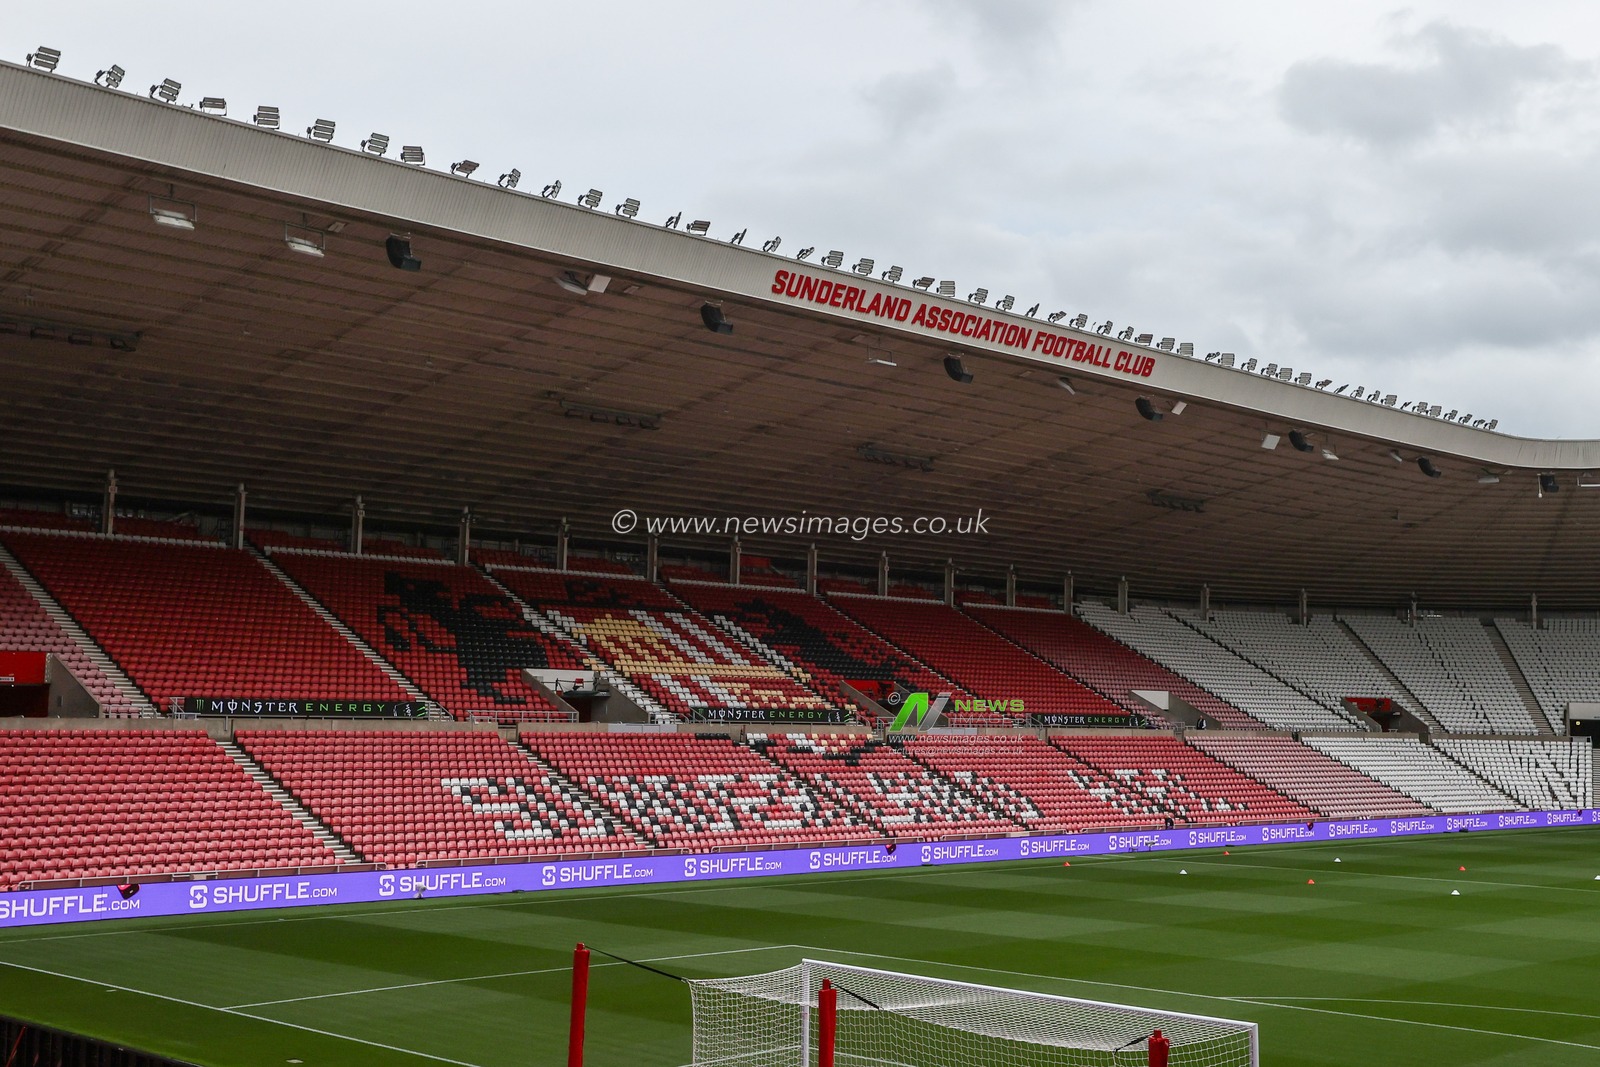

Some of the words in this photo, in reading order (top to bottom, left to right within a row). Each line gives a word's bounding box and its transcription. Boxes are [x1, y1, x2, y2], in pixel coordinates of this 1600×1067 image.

[772, 269, 912, 322] SUNDERLAND
[911, 302, 1032, 350] ASSOCIATION
[1032, 331, 1112, 368] FOOTBALL
[1113, 351, 1156, 377] CLUB
[211, 699, 299, 714] MONSTER
[305, 702, 385, 713] ENERGY
[769, 711, 823, 719] ENERGY
[1270, 827, 1315, 839] SHUFFLE.COM
[1336, 824, 1378, 835] SHUFFLE.COM
[1397, 820, 1435, 831] SHUFFLE.COM
[1198, 831, 1247, 843] SHUFFLE.COM
[933, 845, 999, 860] SHUFFLE.COM
[1031, 840, 1090, 853] SHUFFLE.COM
[700, 856, 782, 874] SHUFFLE.COM
[824, 850, 897, 867] SHUFFLE.COM
[560, 863, 653, 883] SHUFFLE.COM
[400, 872, 505, 893] SHUFFLE.COM
[214, 881, 337, 905] SHUFFLE.COM
[0, 893, 140, 919] SHUFFLE.COM
